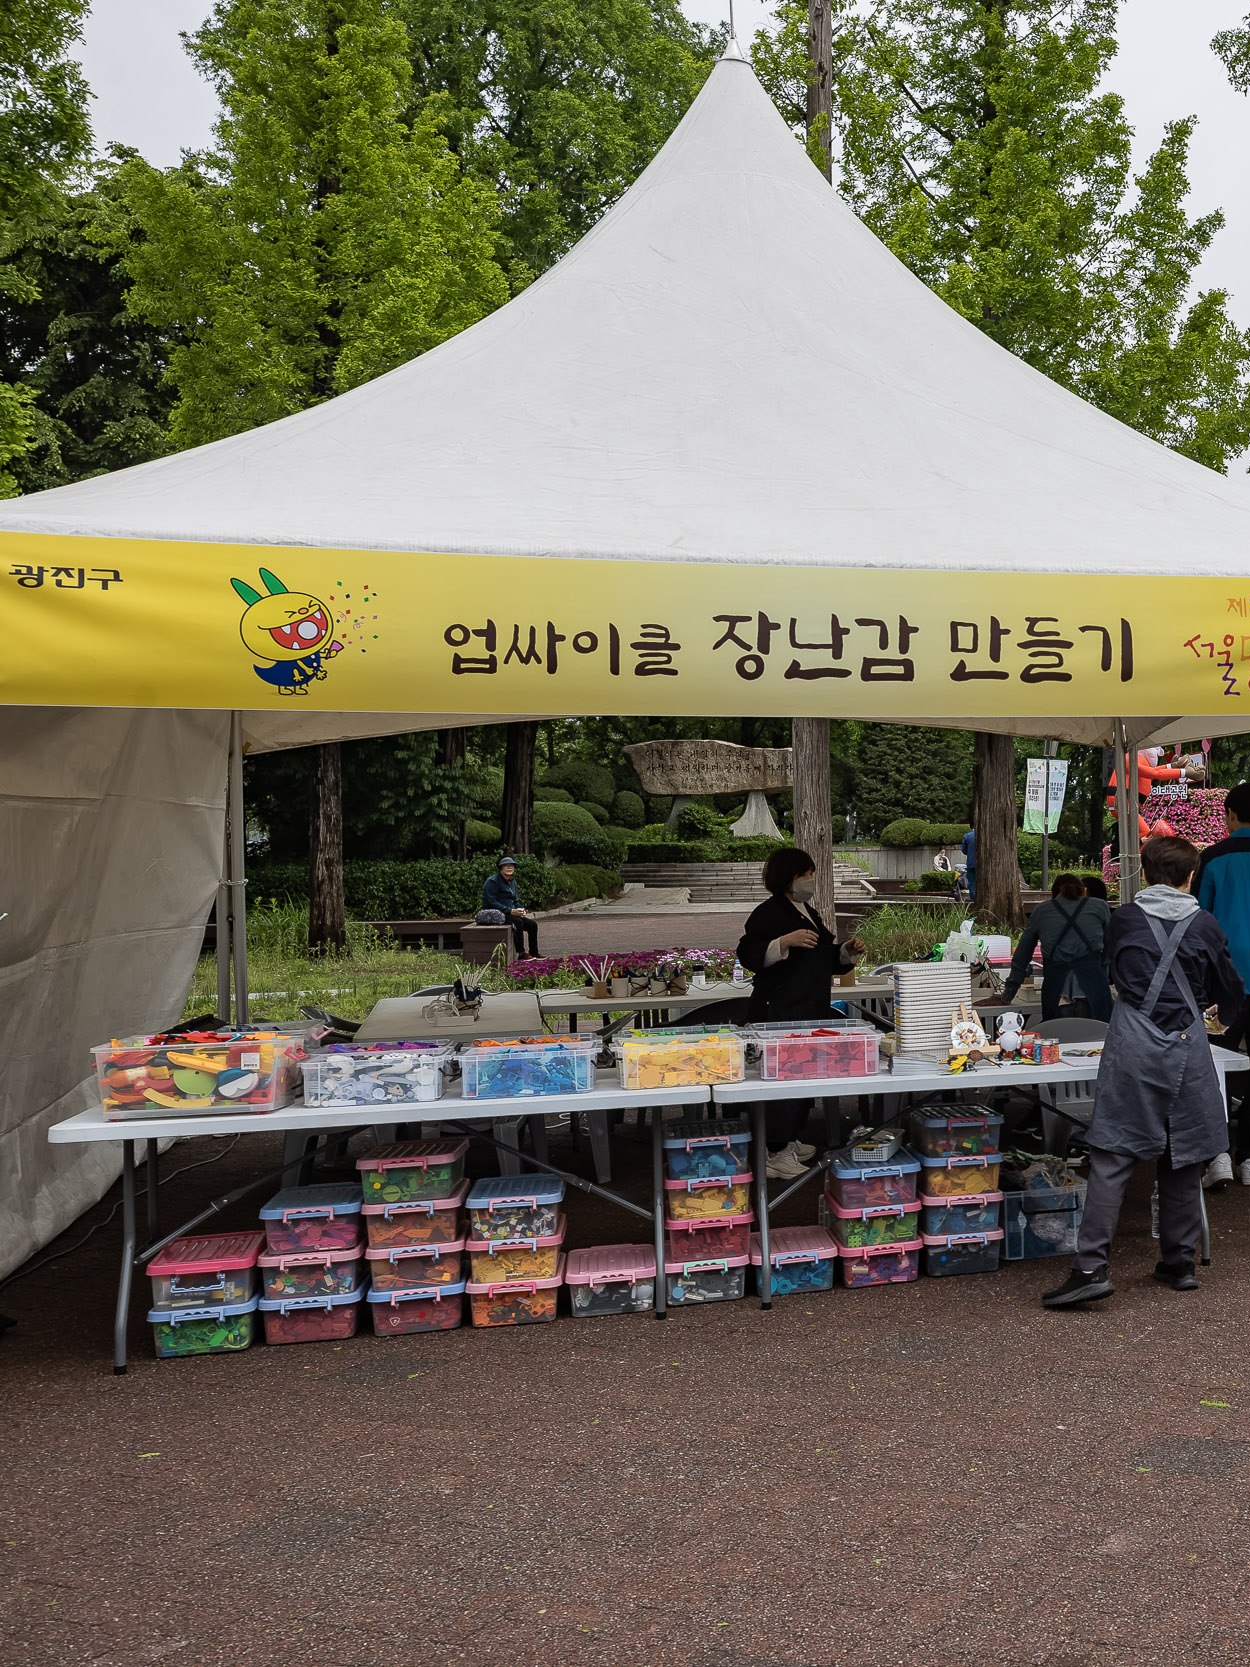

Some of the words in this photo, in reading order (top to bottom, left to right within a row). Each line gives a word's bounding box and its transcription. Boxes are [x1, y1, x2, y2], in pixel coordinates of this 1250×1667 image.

[8, 564, 124, 590] 광진구
[443, 618, 682, 676] 업싸이클
[712, 611, 920, 682] 장난감
[949, 615, 1134, 682] 만들기
